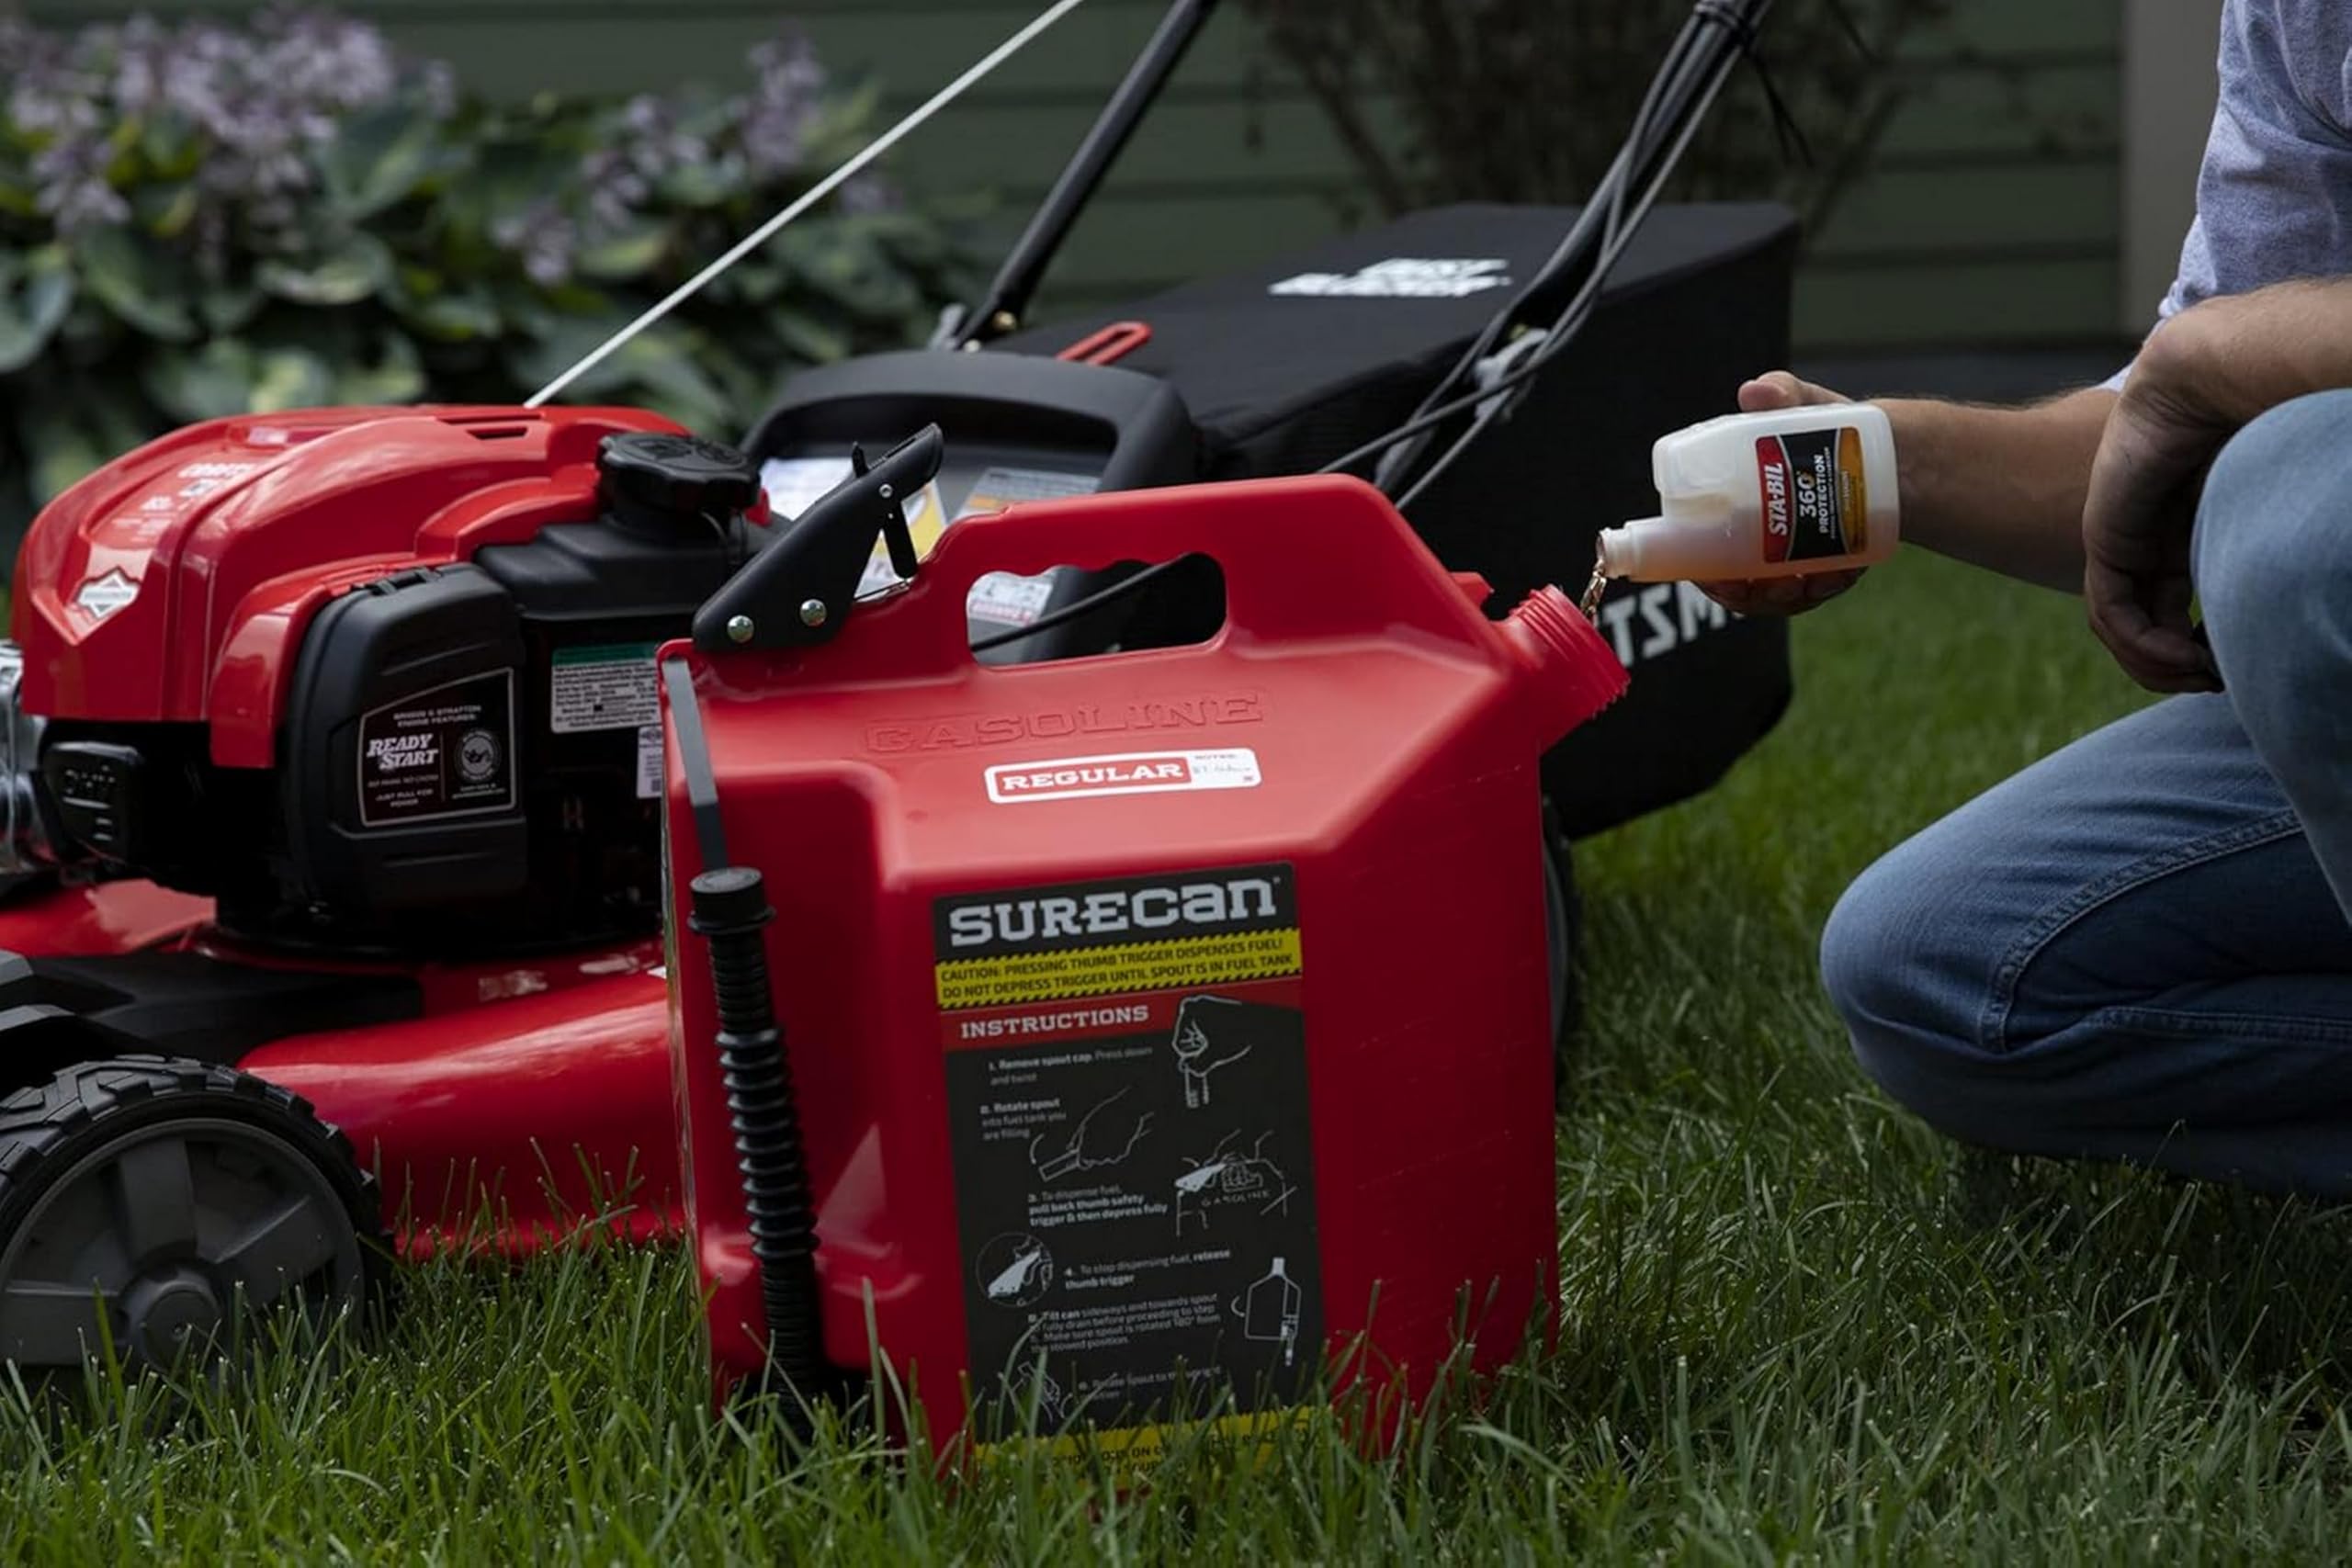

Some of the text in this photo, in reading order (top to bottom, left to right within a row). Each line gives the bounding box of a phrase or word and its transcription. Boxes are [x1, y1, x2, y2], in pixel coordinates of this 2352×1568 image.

[1815, 454, 1829, 534] PROTECTION
[866, 693, 1263, 752] GASOLINE
[367, 734, 434, 758] READY
[379, 749, 439, 772] START
[1002, 761, 1184, 791] REGULAR
[942, 938, 1283, 982] CAUTION: PRESSING THUMB TRIGGER DISPENSES FUEL!
[943, 953, 1294, 999] DO NOT DEPRESS TRIGGER UNTIL SPOUT IS IN FUEL TANK
[961, 1006, 1149, 1039] INSTRUCTIONS
[1041, 1054, 1071, 1066] spout
[1028, 1193, 1145, 1215] pull back thumb safety
[1029, 1214, 1066, 1227] trigger
[1076, 1209, 1101, 1222] then
[1102, 1206, 1143, 1219] depress
[1143, 1202, 1168, 1214] fully
[1193, 1249, 1230, 1262] release
[1065, 1273, 1136, 1290] thumb trigger
[1061, 1309, 1080, 1320] can
